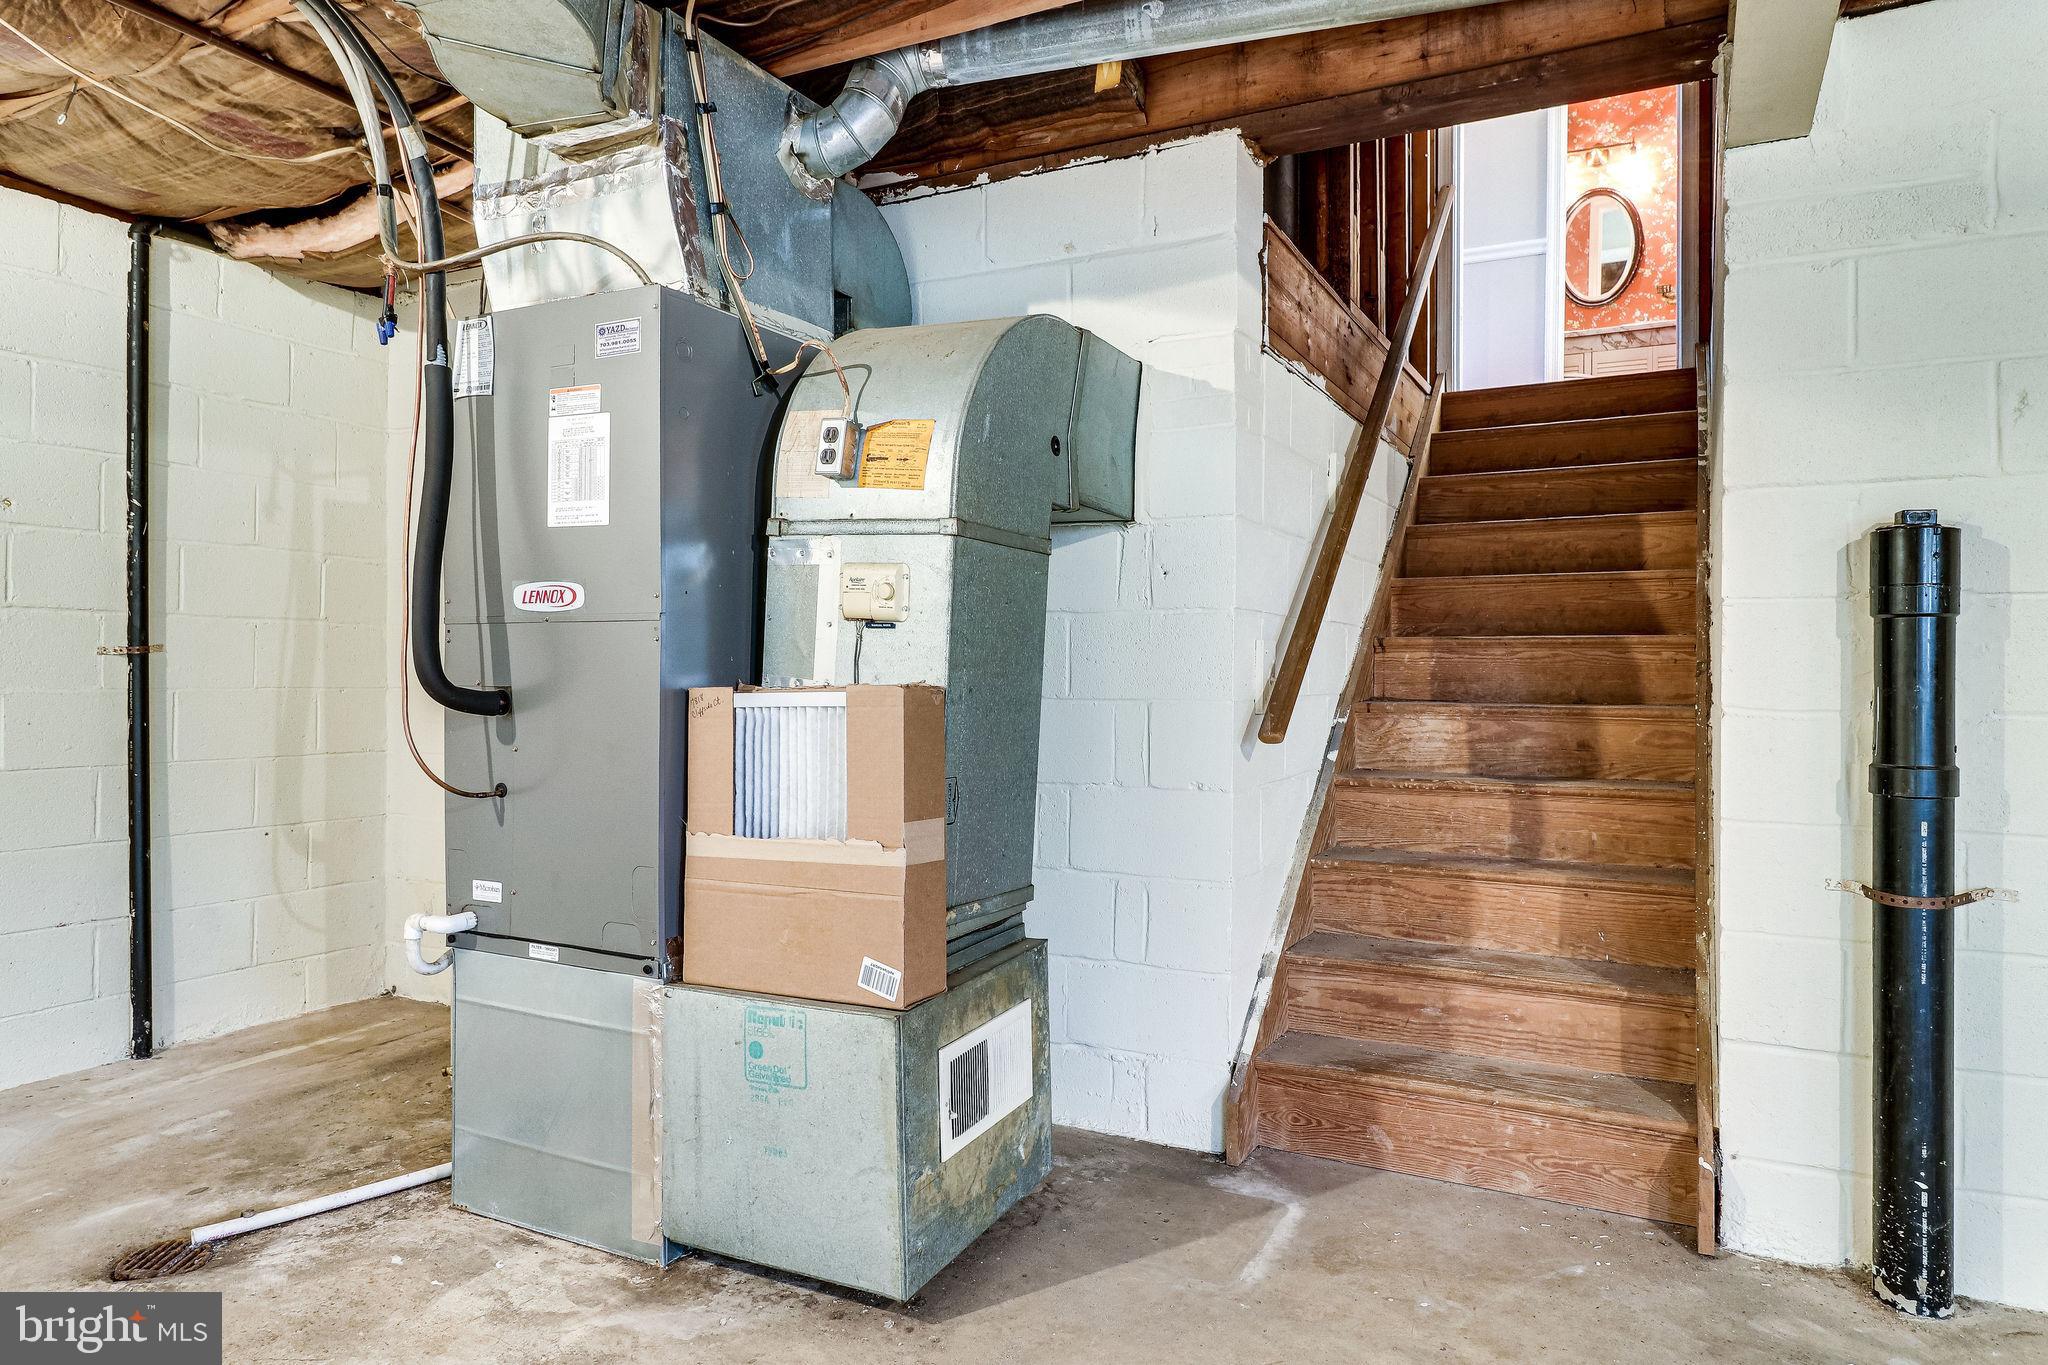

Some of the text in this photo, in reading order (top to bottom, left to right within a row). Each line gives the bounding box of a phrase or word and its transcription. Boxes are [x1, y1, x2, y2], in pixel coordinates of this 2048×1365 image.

[606, 324, 626, 334] YAZD
[522, 589, 566, 604] LENNOX
[748, 1061, 773, 1074] Green
